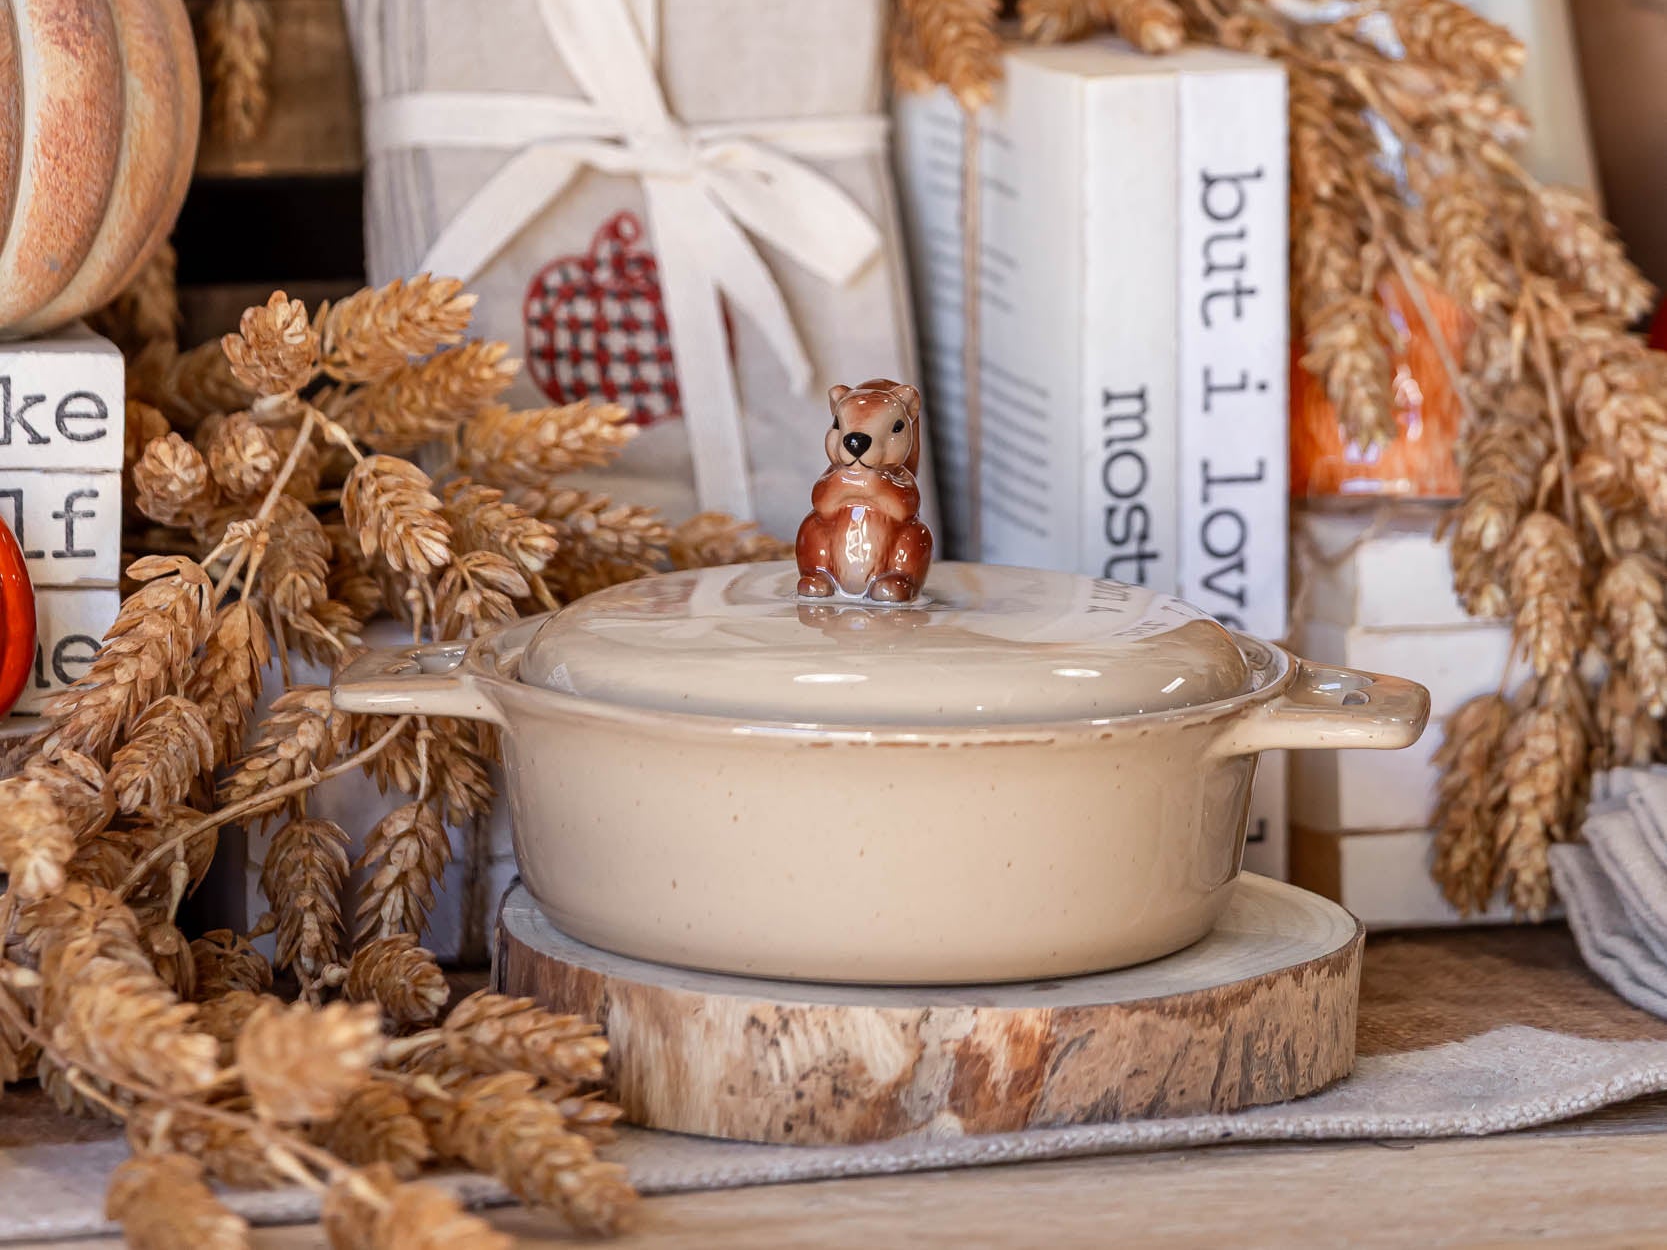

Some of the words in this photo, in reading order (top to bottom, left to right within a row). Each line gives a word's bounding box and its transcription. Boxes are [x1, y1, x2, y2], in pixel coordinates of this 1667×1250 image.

[1200, 166, 1265, 329] but
[1202, 367, 1269, 414] i
[1101, 383, 1160, 586] most
